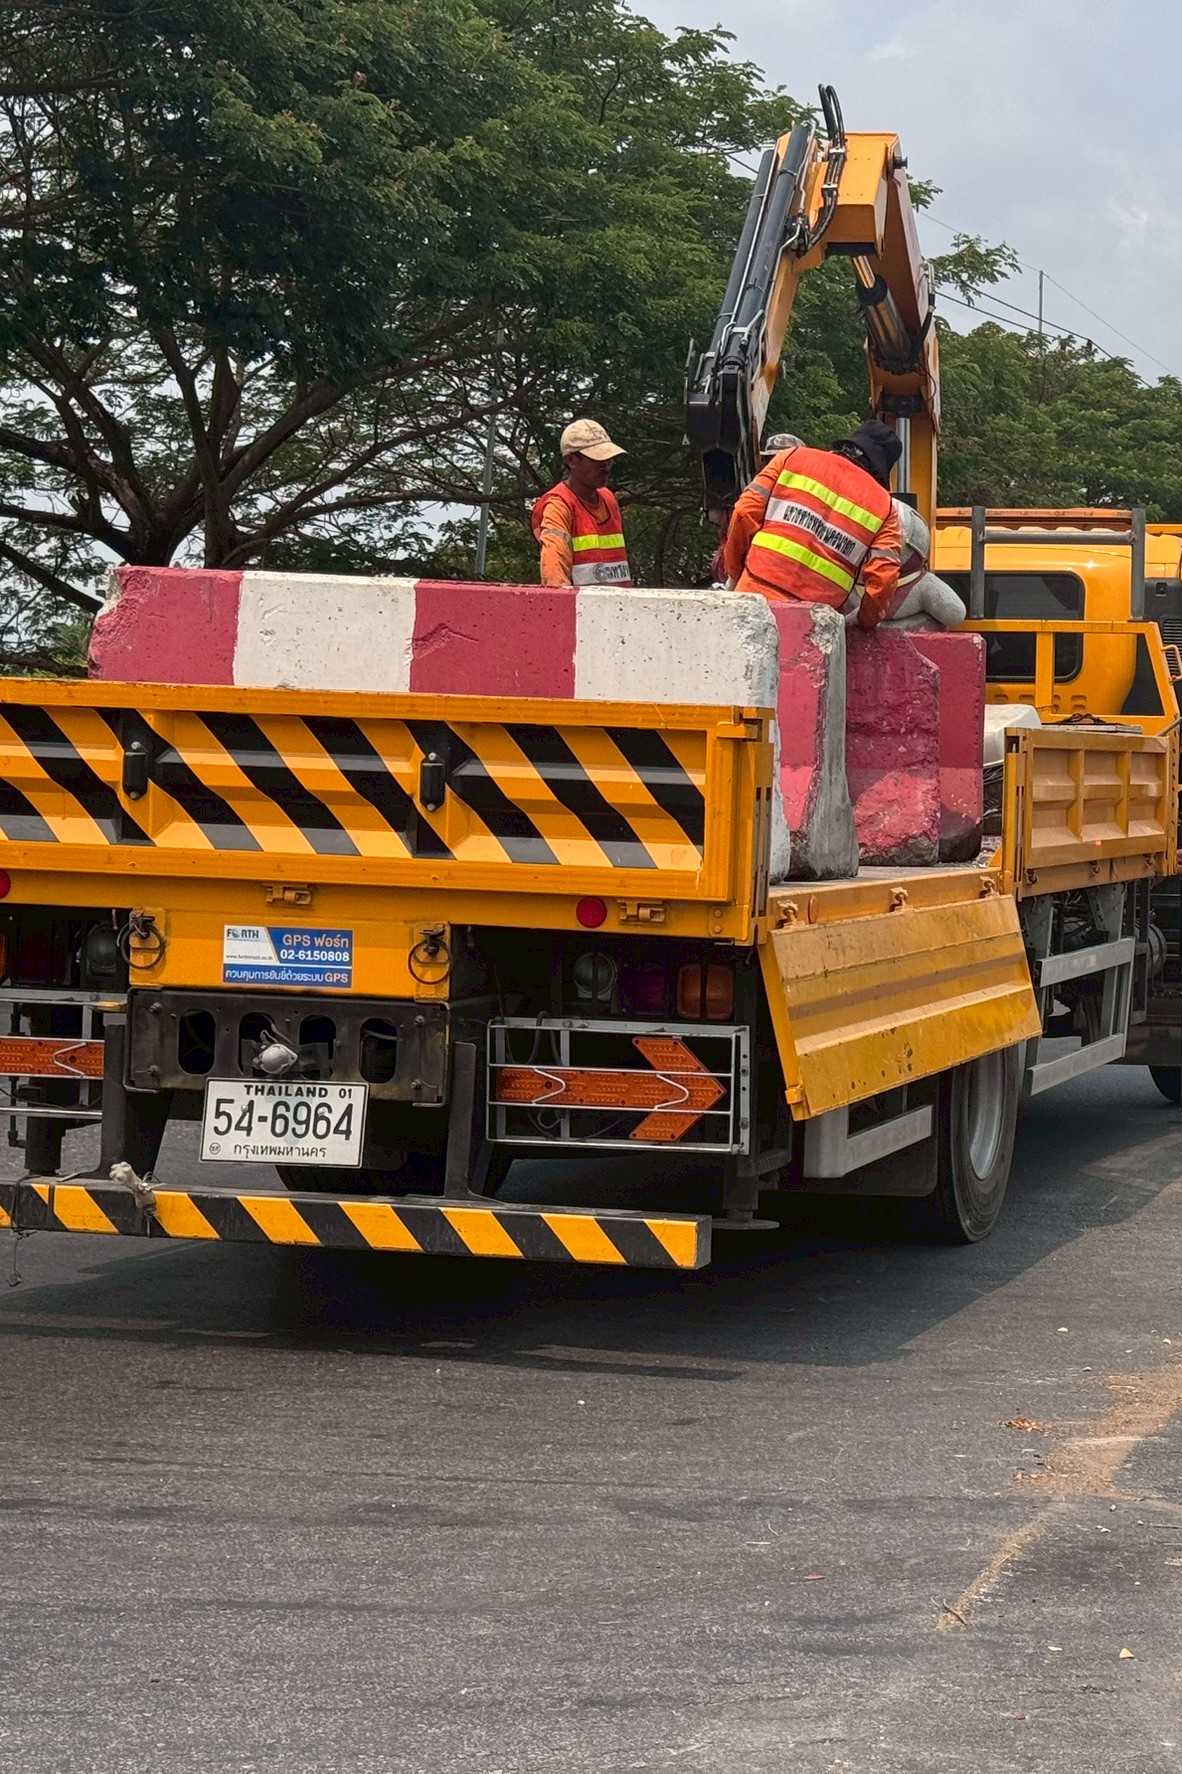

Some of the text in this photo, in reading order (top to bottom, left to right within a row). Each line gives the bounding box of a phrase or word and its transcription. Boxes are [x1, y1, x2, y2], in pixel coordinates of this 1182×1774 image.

[226, 928, 259, 938] FORTH
[282, 934, 311, 947] GPS
[280, 949, 350, 962] 02-6150808
[324, 973, 349, 983] GPS
[244, 1084, 352, 1099] THAILAND 01
[213, 1098, 354, 1141] 54-6964
[233, 1144, 327, 1159] กรุงเทพมหานคร
